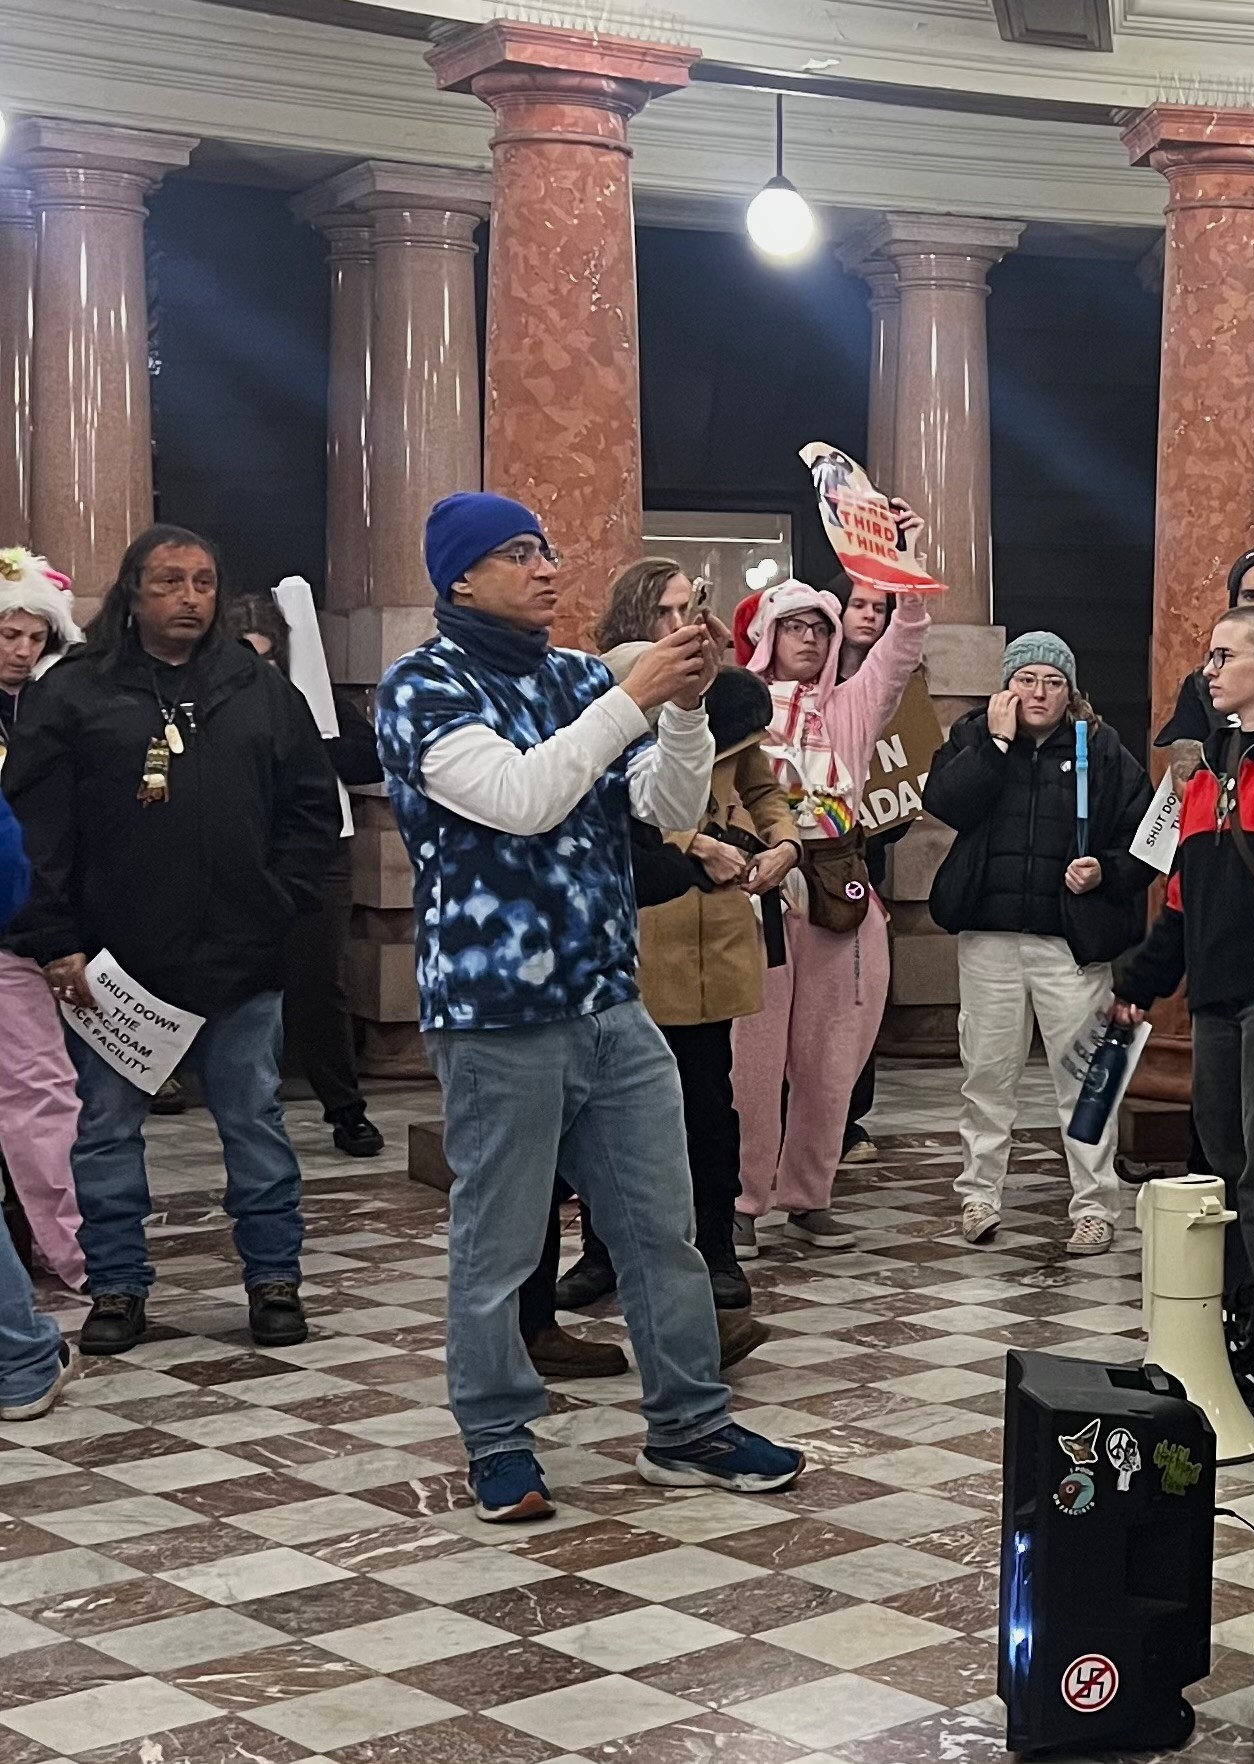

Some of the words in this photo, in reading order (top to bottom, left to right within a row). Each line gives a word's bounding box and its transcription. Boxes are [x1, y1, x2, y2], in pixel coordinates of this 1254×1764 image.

[840, 511, 895, 542] THIRD
[844, 530, 899, 561] THING
[868, 734, 908, 778] N
[858, 772, 928, 830] ADA
[1146, 814, 1166, 847] SHUT
[1162, 792, 1177, 814] DO
[97, 973, 134, 1004] SHUT
[133, 1003, 180, 1032] DOWN
[111, 1007, 141, 1032] THE
[72, 1005, 93, 1029] ICE
[92, 1029, 151, 1074] FACILITY
